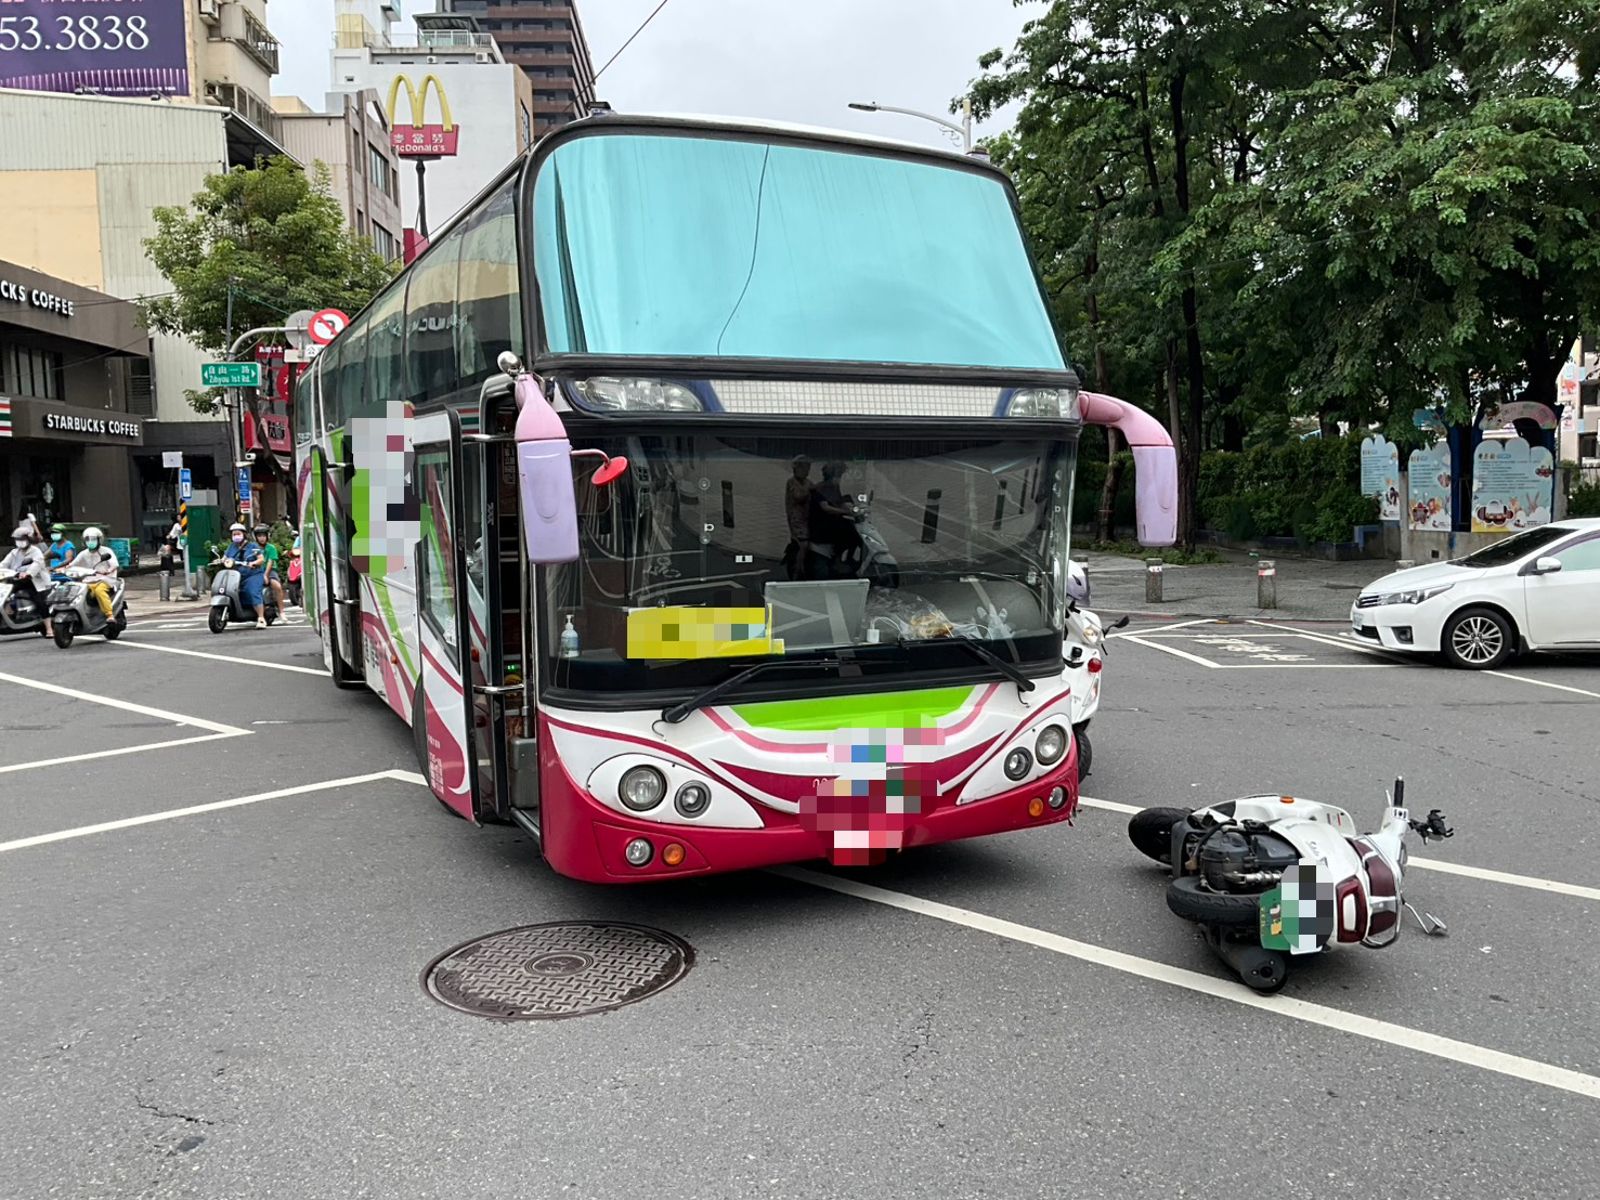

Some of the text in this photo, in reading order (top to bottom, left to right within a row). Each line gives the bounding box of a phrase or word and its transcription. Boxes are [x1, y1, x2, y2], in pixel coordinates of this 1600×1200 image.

[0, 15, 149, 51] 53.3838
[31, 289, 75, 316] COFFEE
[47, 413, 139, 437] STARBUCKS COFFEE
